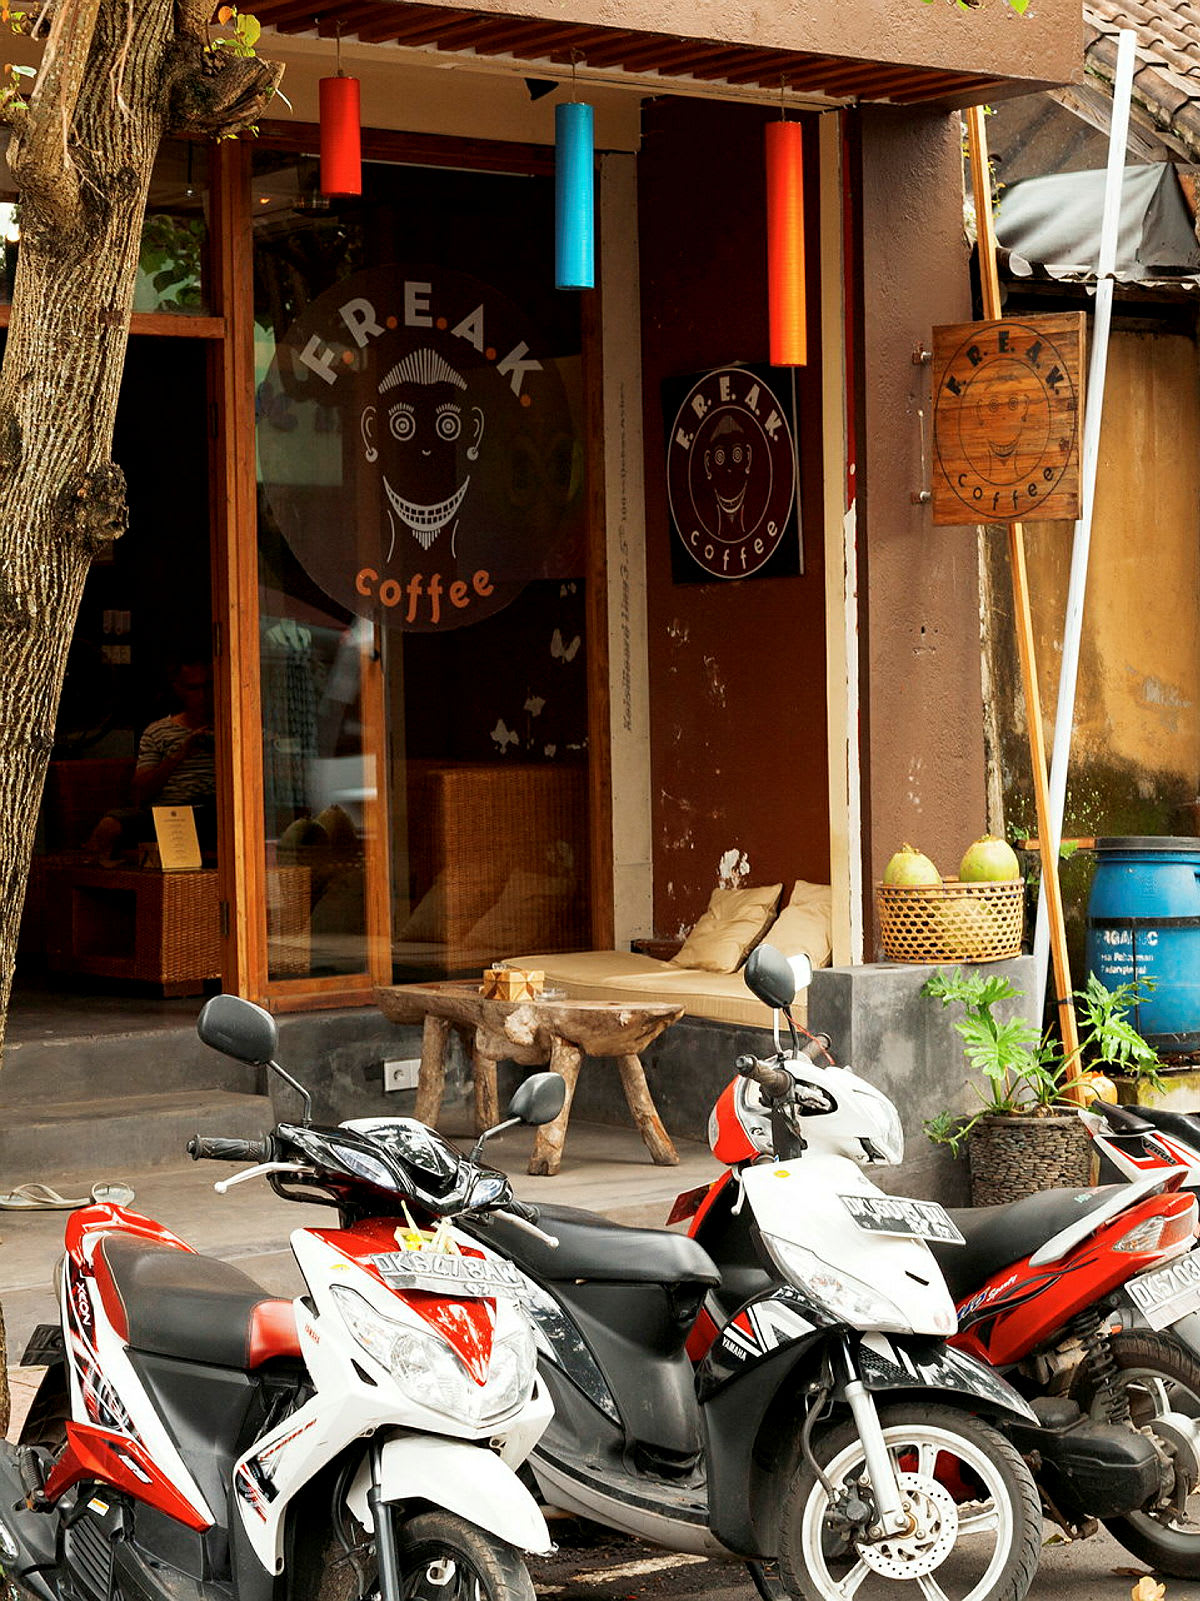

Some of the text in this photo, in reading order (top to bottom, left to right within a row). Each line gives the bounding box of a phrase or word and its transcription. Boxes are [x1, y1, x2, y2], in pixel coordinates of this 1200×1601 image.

[958, 467, 1054, 510] coffee
[691, 520, 778, 570] coffee
[356, 568, 494, 623] coffee
[722, 1336, 748, 1362] YAMAHA
